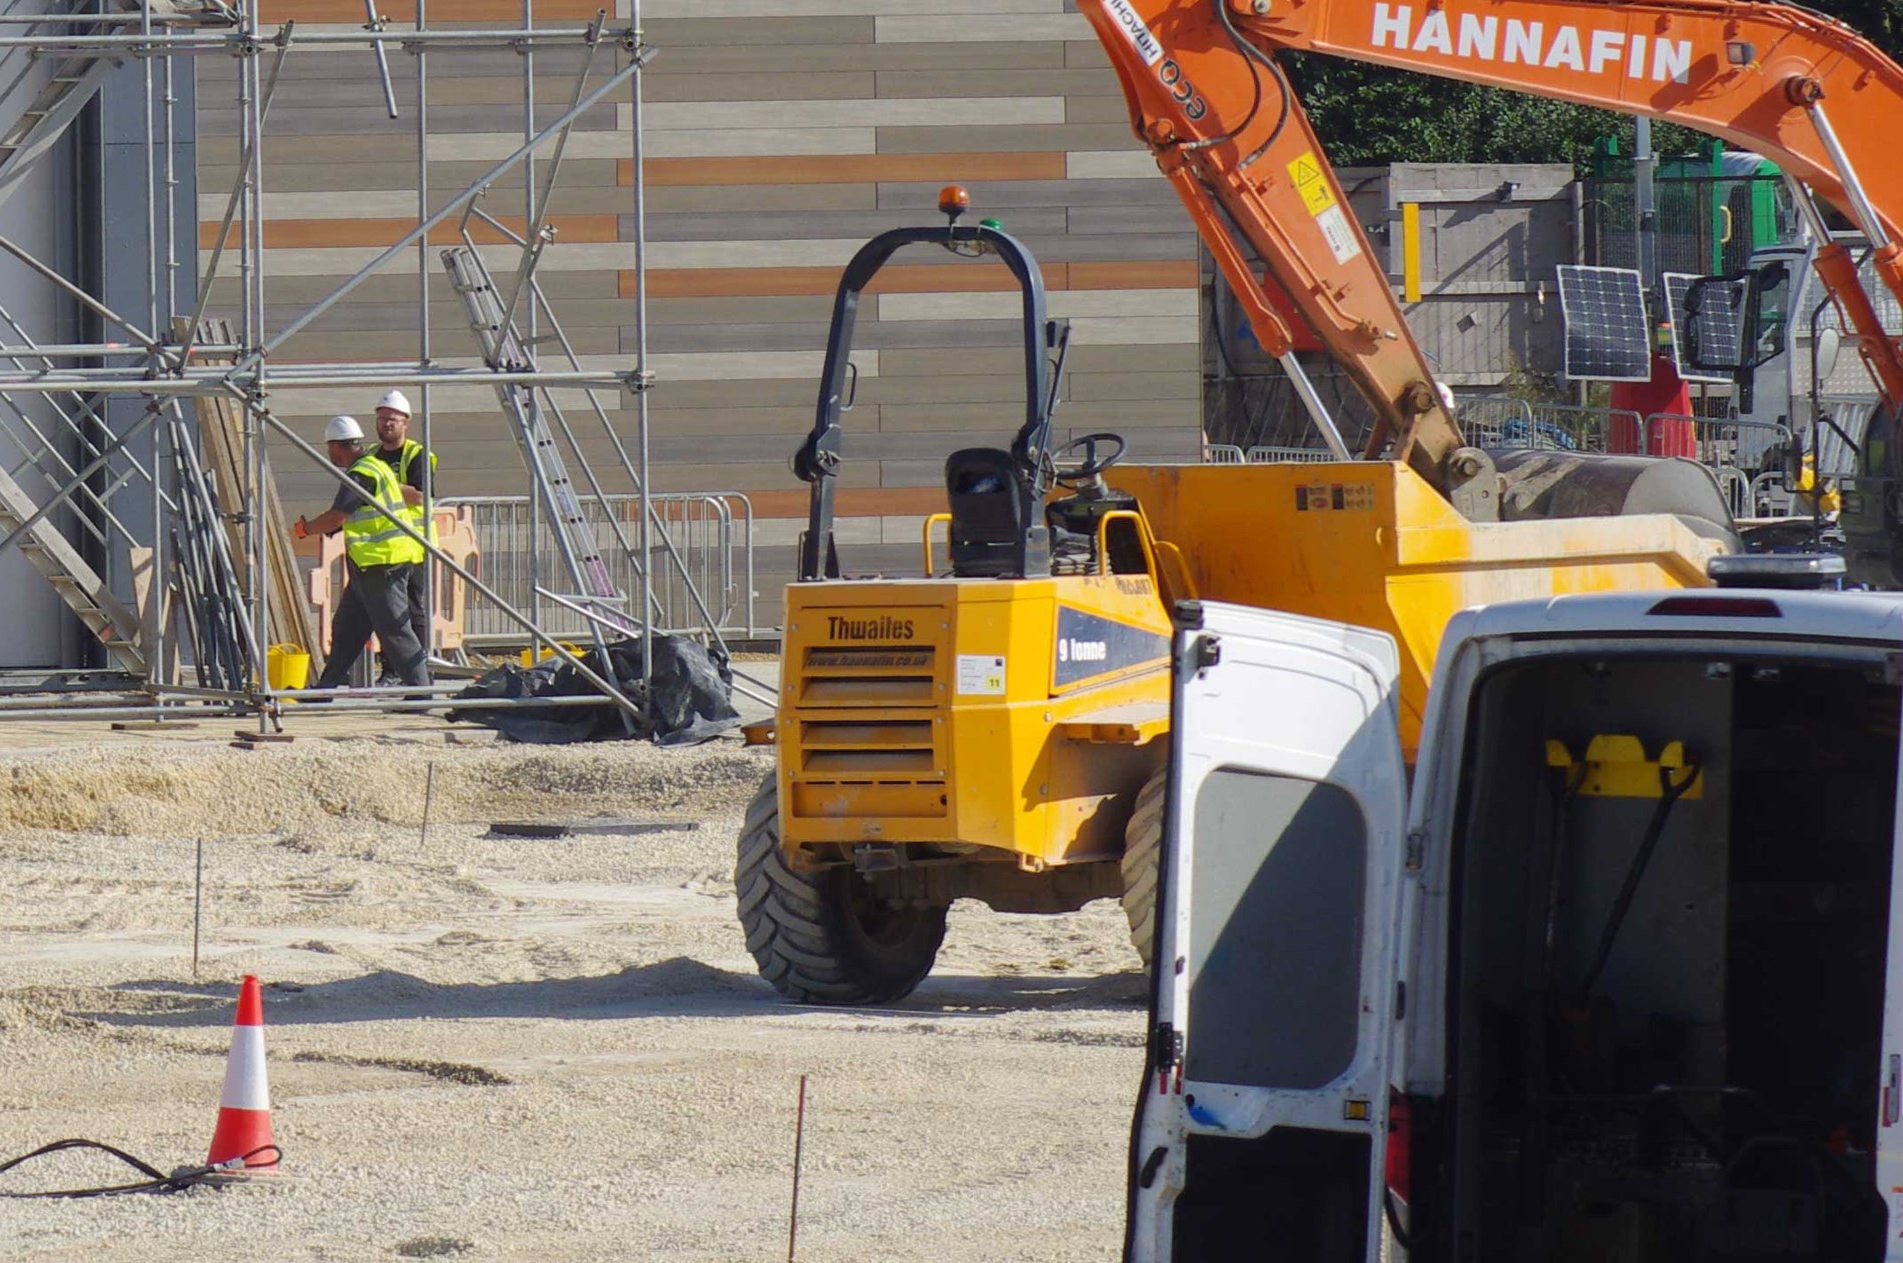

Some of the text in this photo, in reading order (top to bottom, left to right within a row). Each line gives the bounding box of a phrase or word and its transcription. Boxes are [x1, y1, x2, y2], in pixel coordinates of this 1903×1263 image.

[1370, 1, 1693, 86] HANNAFIN
[826, 615, 915, 640] Thwaites
[1058, 637, 1107, 662] 9 tonne
